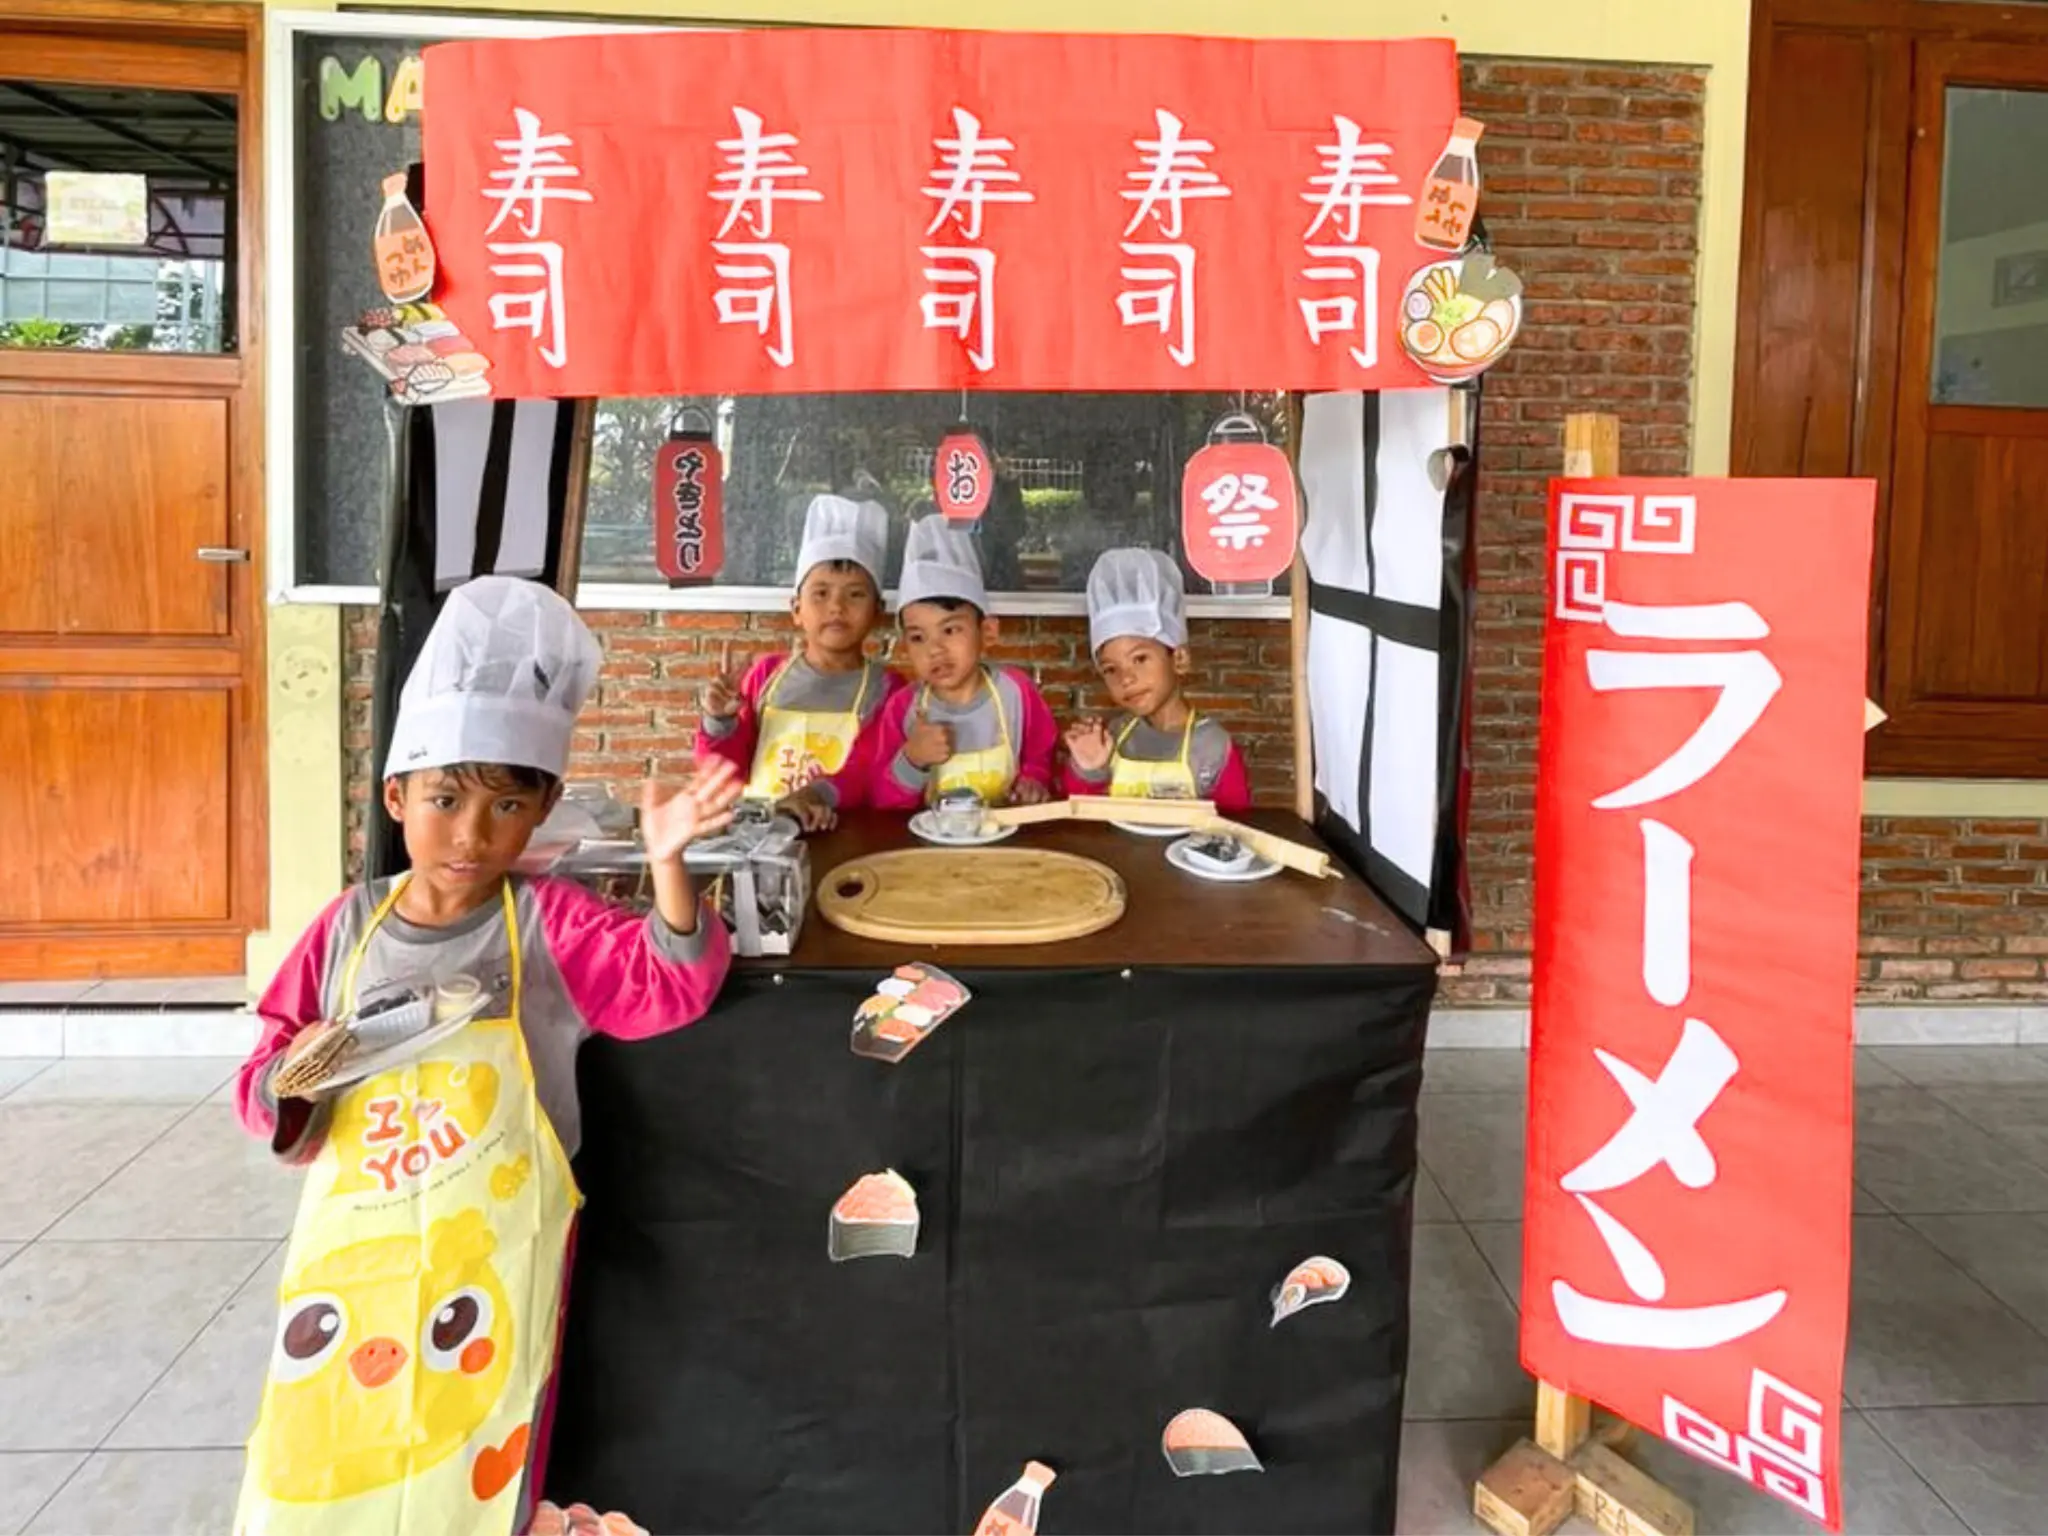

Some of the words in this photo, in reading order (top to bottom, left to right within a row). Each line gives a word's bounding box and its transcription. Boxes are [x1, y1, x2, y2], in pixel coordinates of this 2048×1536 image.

[480, 106, 594, 369] 寿司
[708, 106, 824, 368] 寿司
[920, 107, 1034, 372] 寿司
[1116, 108, 1232, 367] 寿司
[1298, 115, 1415, 368] 寿司
[947, 450, 980, 503] お
[1200, 472, 1280, 550] 祭
[1550, 600, 1788, 1351] ラーメン
[366, 1100, 404, 1142] I
[366, 1121, 467, 1193] YOU
